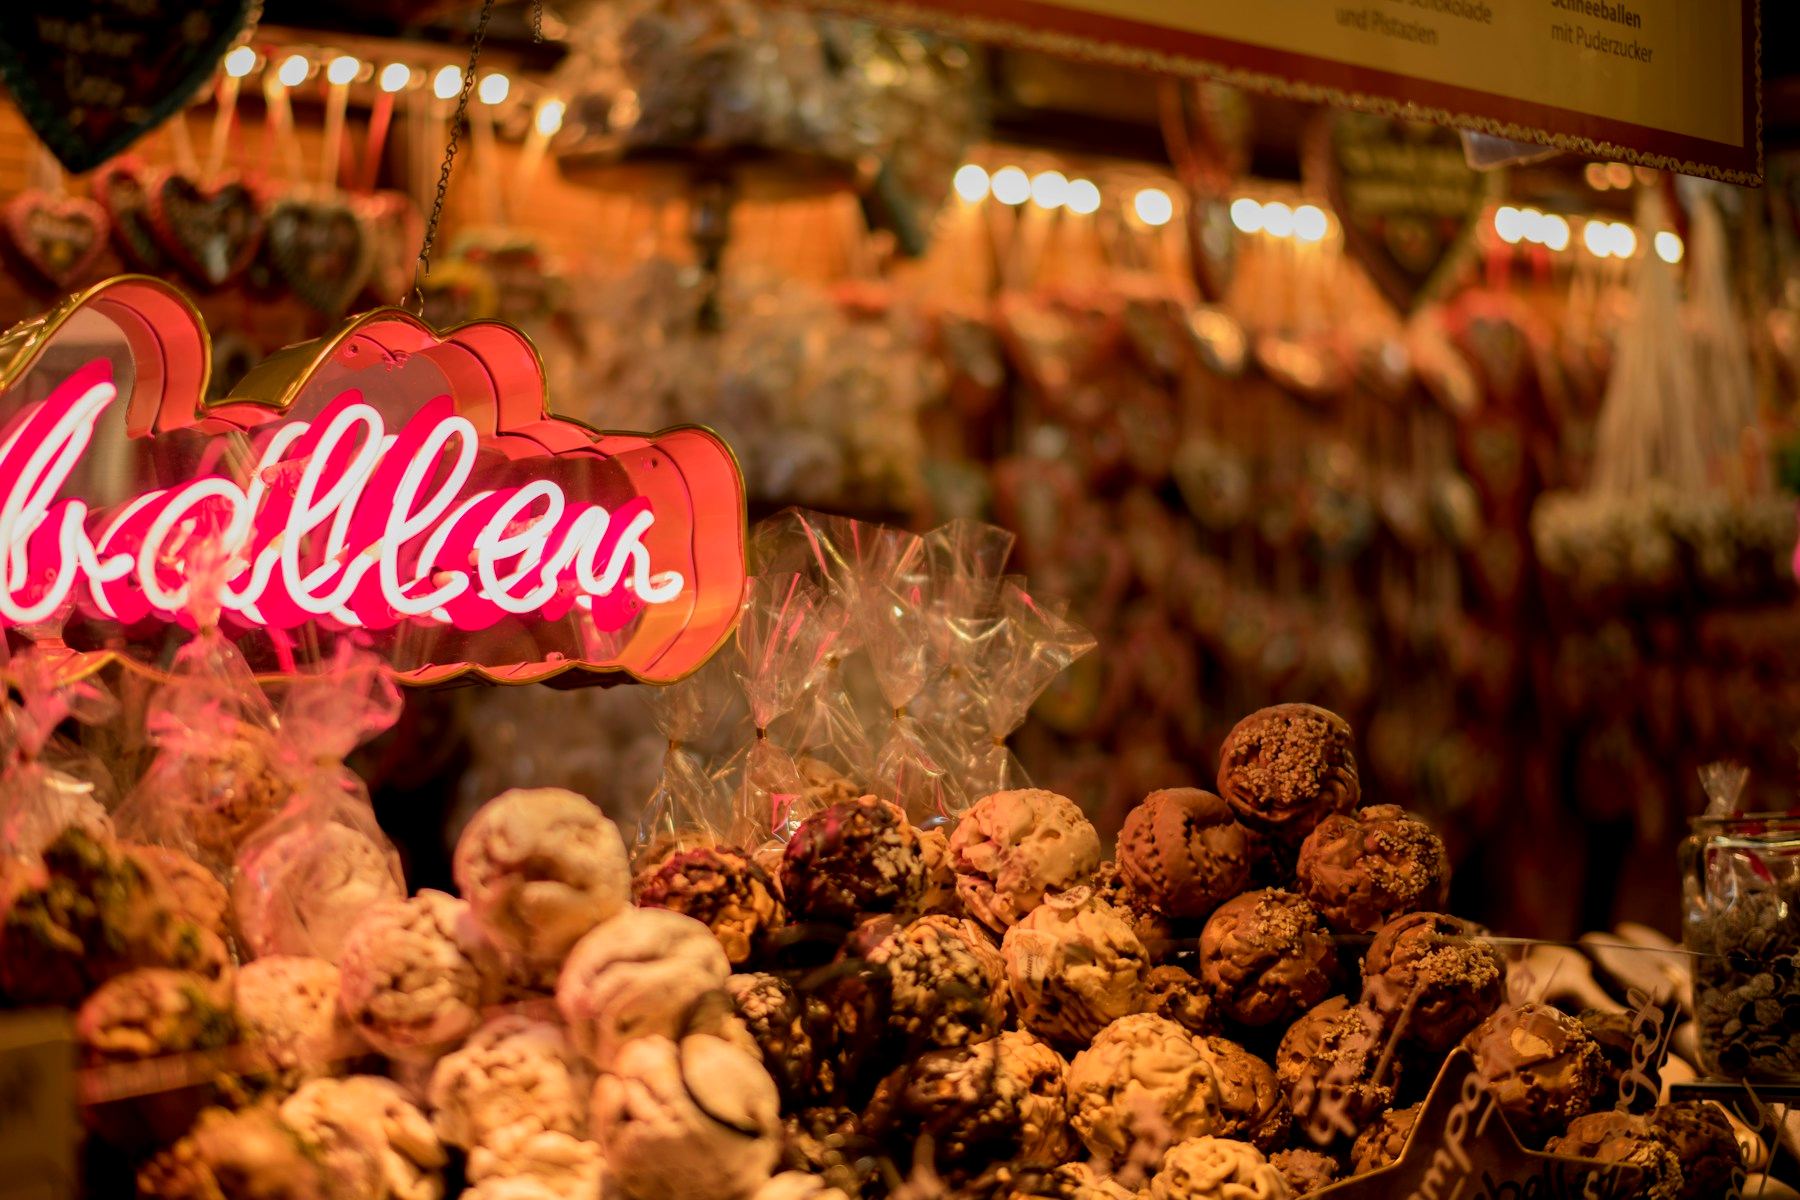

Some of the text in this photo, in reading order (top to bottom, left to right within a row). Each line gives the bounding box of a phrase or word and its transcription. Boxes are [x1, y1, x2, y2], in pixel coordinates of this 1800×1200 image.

[1335, 7, 1440, 45] und Pistazien
[1551, 23, 1653, 63] mit Puderzucker
